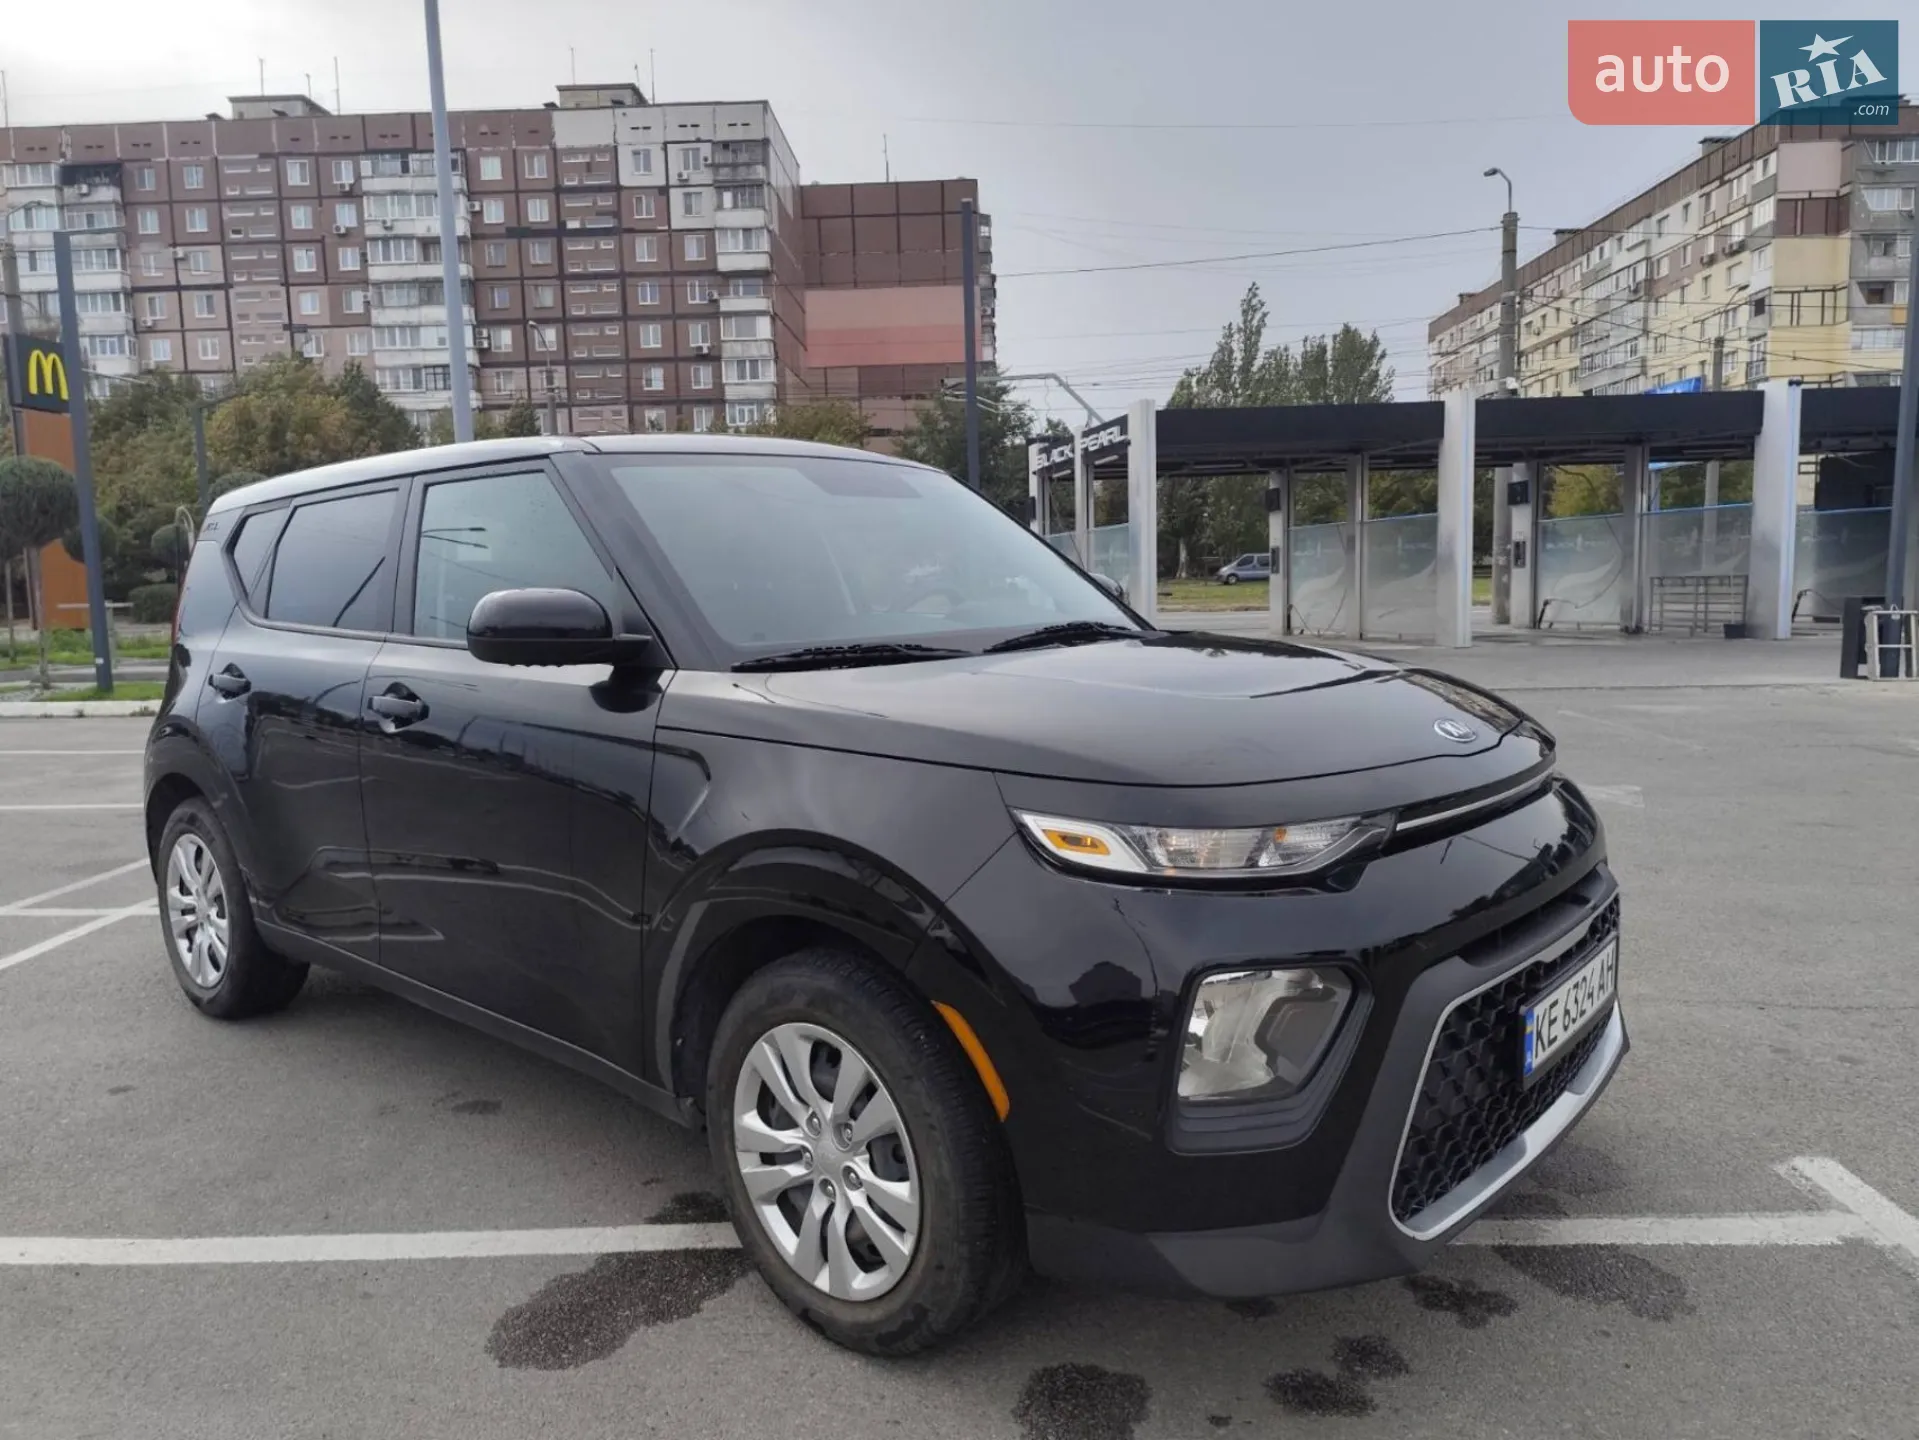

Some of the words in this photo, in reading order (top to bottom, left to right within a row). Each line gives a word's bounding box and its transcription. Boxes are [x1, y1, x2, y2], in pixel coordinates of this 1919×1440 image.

[1036, 444, 1074, 468] BLACK
[1080, 425, 1129, 452] PEARL
[1534, 998, 1559, 1060] KE
[1562, 967, 1596, 1032] 6324
[1597, 947, 1615, 1001] AH
